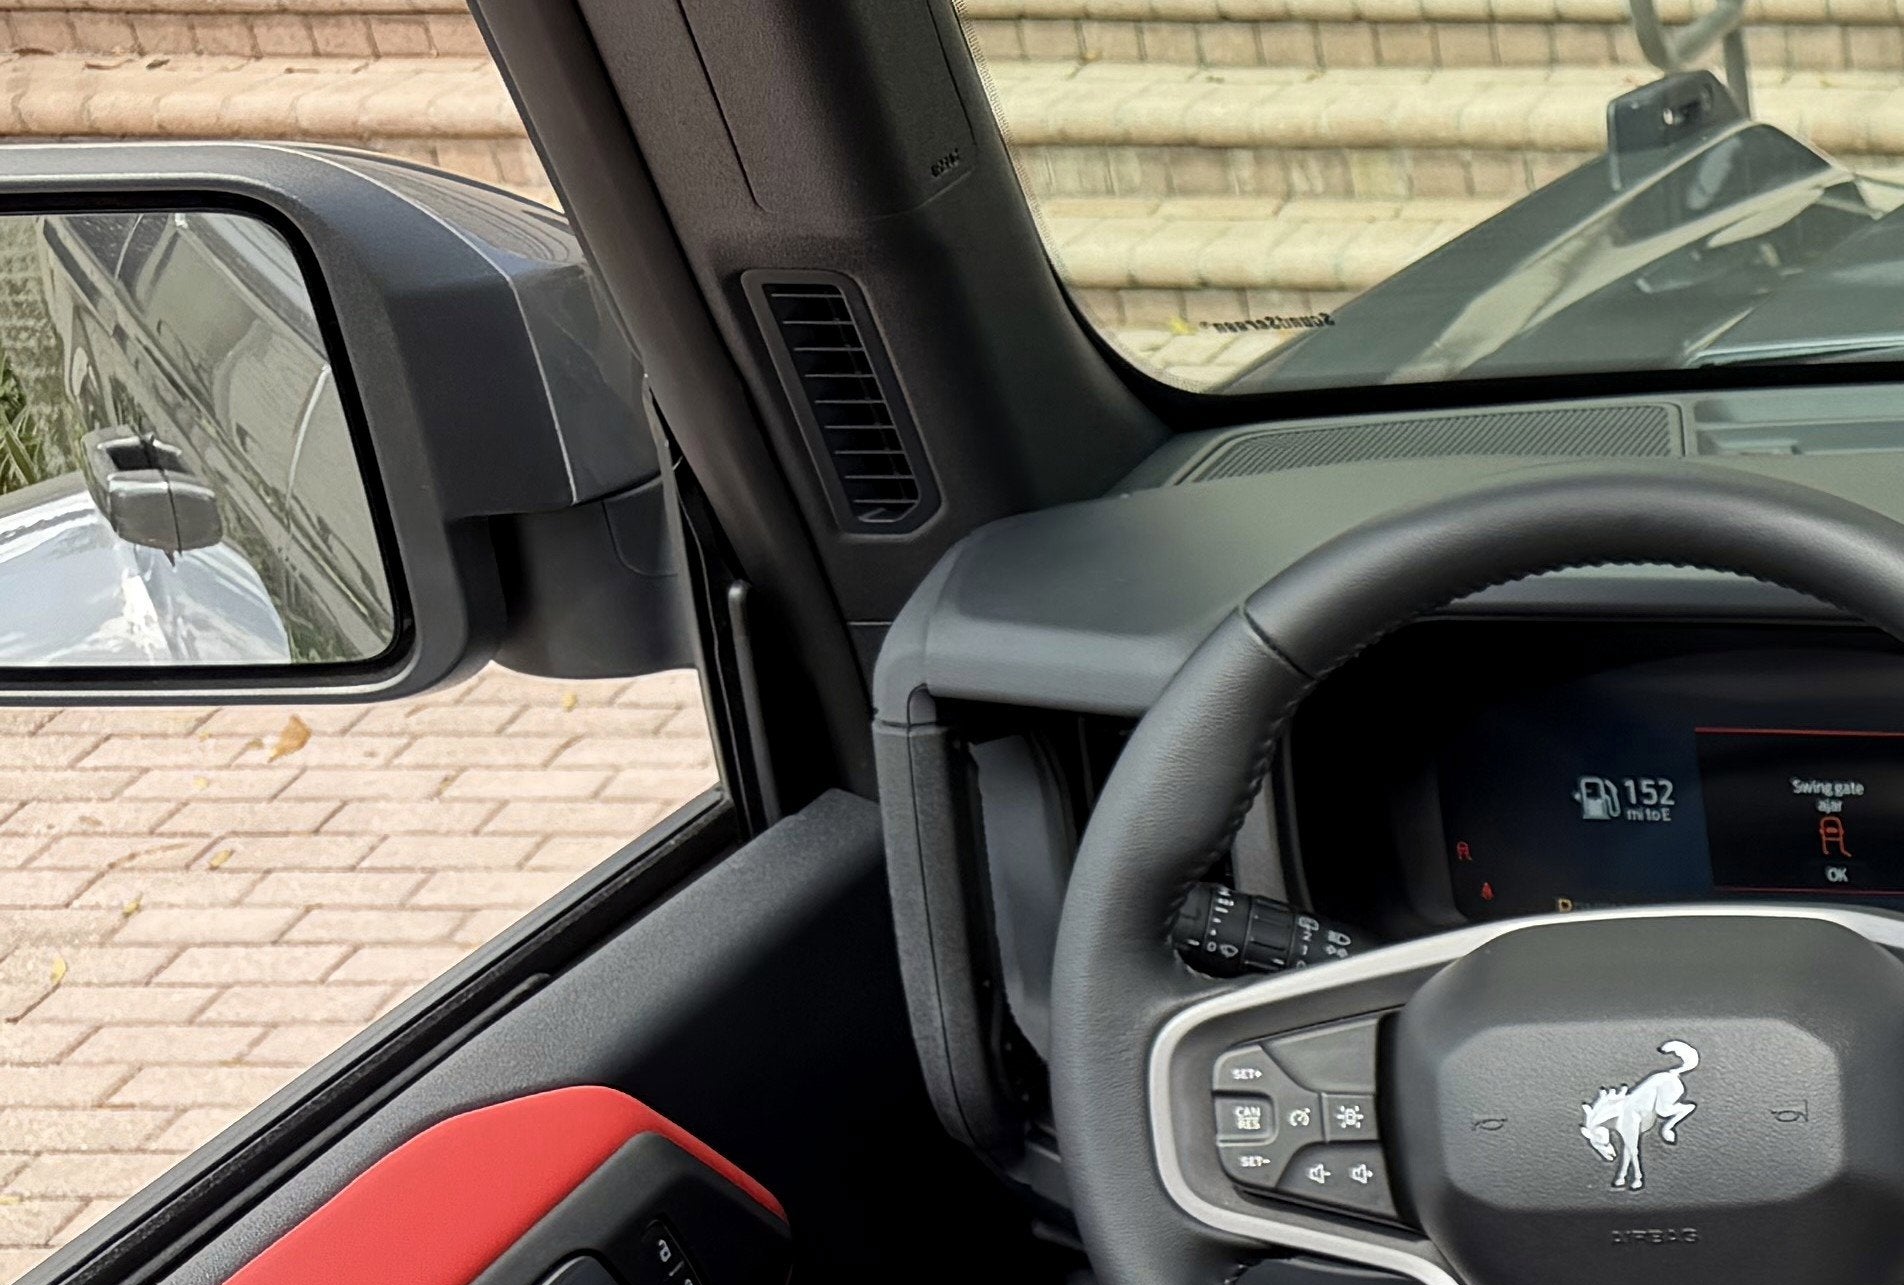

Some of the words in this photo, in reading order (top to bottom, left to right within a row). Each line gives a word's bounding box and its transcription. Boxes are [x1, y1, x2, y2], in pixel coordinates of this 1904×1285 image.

[1624, 779, 1675, 805] 152
[1792, 780, 1833, 797] Swing
[1834, 781, 1865, 797] gate
[1818, 801, 1843, 814] ajar
[1627, 808, 1644, 821] mi
[1646, 808, 1661, 821] to
[1662, 808, 1671, 822] E
[1826, 867, 1848, 882] OK
[1232, 1067, 1263, 1080] SET+
[1235, 1106, 1261, 1117] CAN
